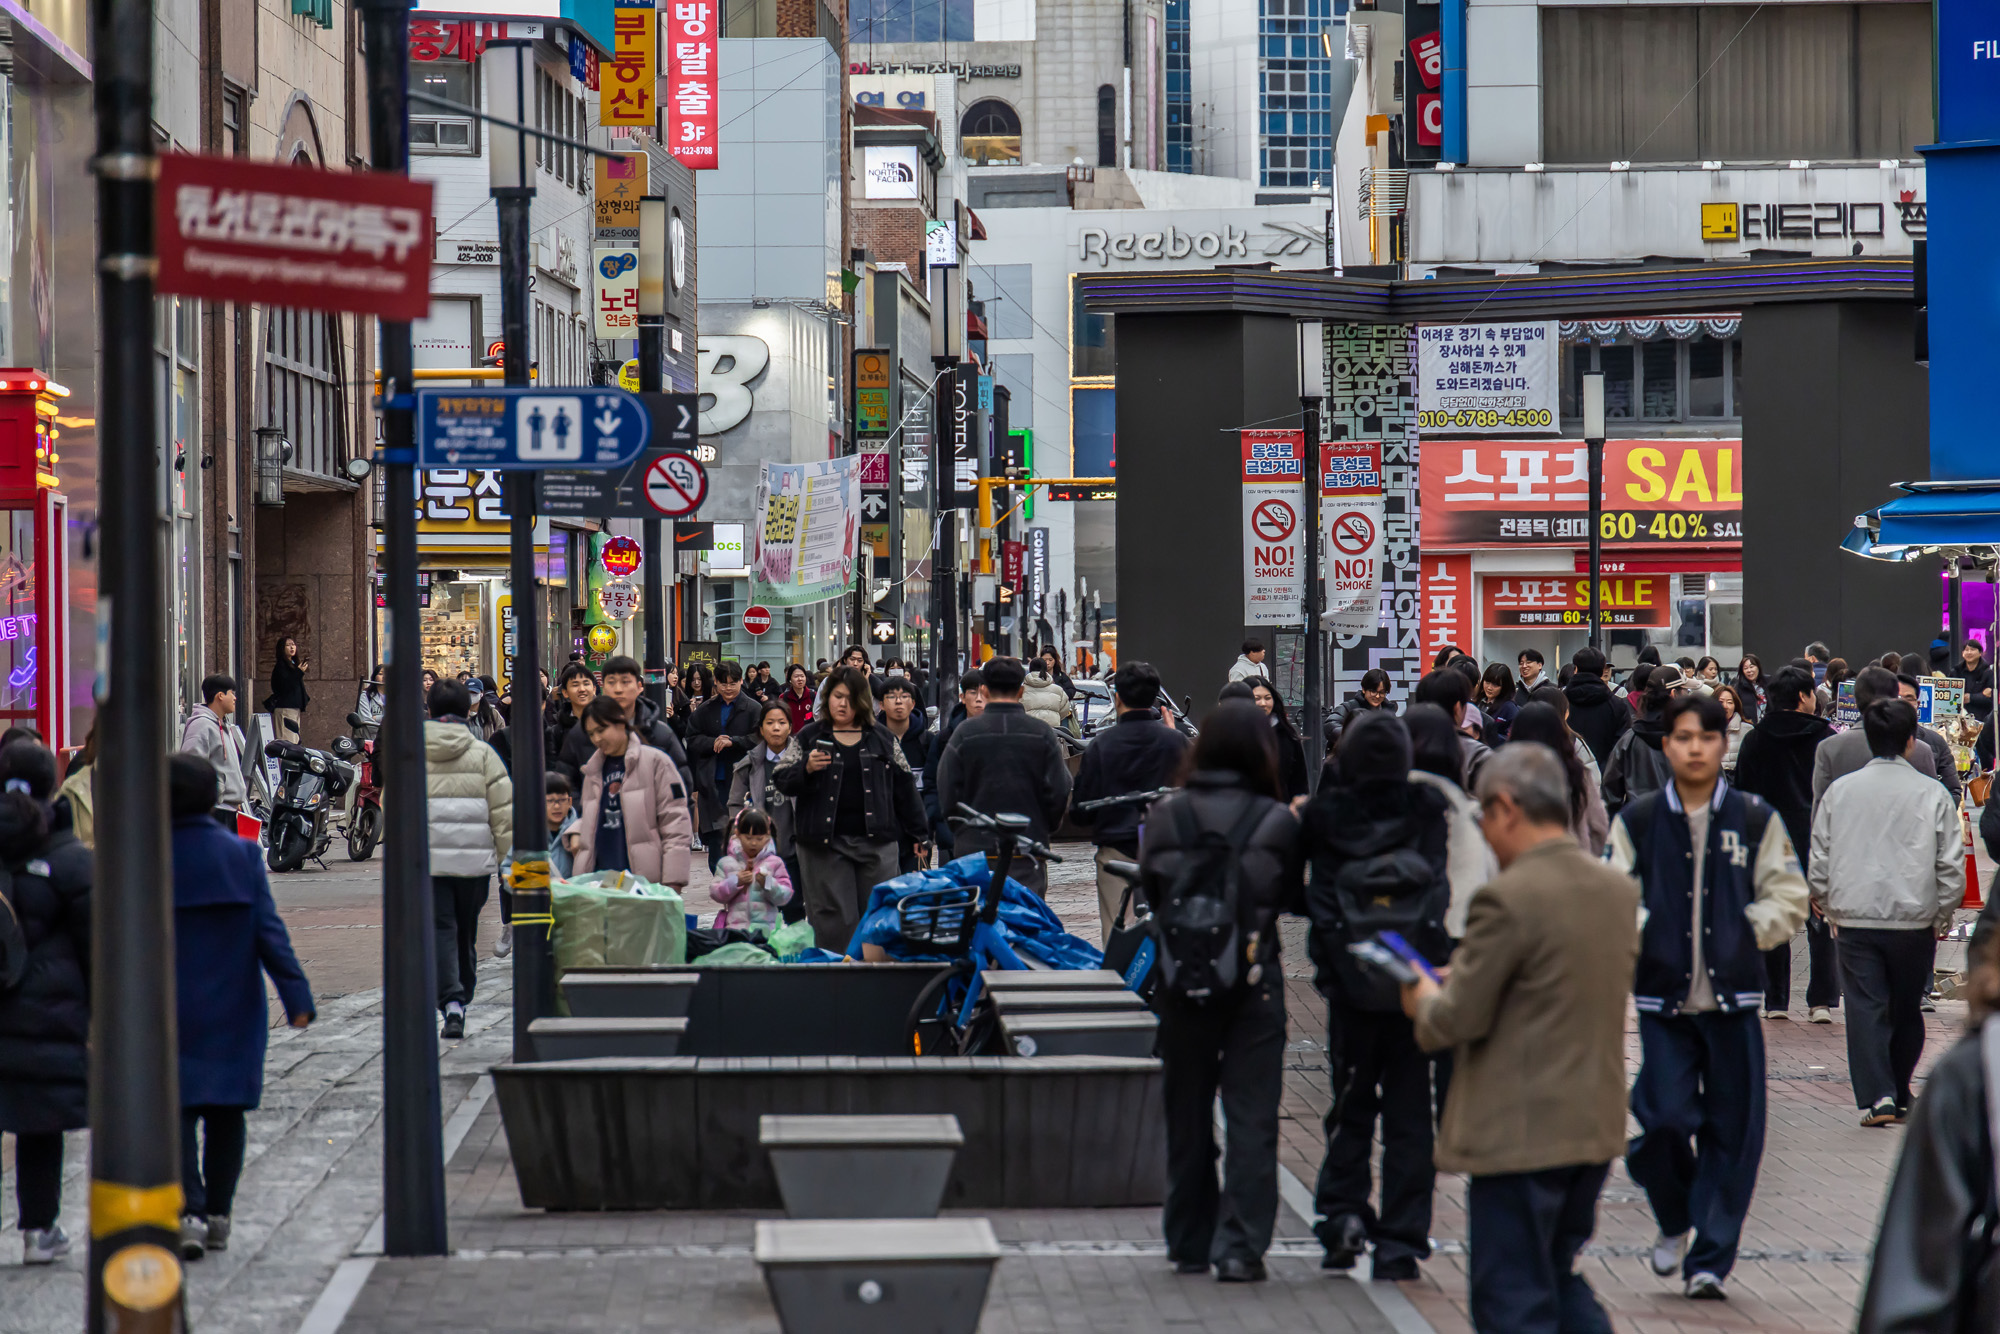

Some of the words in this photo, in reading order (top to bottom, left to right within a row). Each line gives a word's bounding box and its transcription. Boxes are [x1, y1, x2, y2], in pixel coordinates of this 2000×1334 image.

[527, 26, 536, 34] 3F
[675, 3, 711, 115] 방탈출
[611, 15, 648, 118] 부동산
[681, 122, 705, 141] 3F
[681, 146, 712, 155] 422-8788
[597, 215, 613, 225] 의원
[599, 229, 640, 238] 425-000
[1079, 224, 1248, 267] Reebok
[457, 253, 493, 262] 425-0009
[1421, 328, 1454, 341] 어려운
[1458, 328, 1481, 341] 경기
[1485, 328, 1496, 341] 속
[1500, 327, 1545, 341] 부담없이
[1439, 344, 1485, 358] 장사하실
[1489, 344, 1500, 357] 수
[1504, 344, 1526, 358] 있게
[1448, 361, 1517, 374] 심해돈까스가
[1435, 377, 1530, 391] 도와드리겠습니다.
[858, 392, 885, 404] 보드
[1440, 396, 1477, 408] 부담없이
[1478, 396, 1527, 408] 전화주세요!
[861, 405, 888, 420] 게임
[1419, 409, 1552, 427] 010-6788-4500
[1252, 443, 1293, 459] 동성로
[861, 455, 885, 468] 성형
[1246, 459, 1300, 474] 금연거리
[1331, 456, 1372, 471] 동성로
[1325, 471, 1379, 488] 금연거리
[1444, 448, 1607, 502] 스포츠
[1500, 517, 1588, 537] 전품목(최대
[713, 540, 741, 551] ocs
[606, 550, 637, 567] 노래
[1254, 546, 1295, 566] NO!
[1254, 567, 1295, 578] SMOKE
[1334, 558, 1374, 579] NO!
[1336, 580, 1373, 591] SMOKE
[602, 592, 639, 608] 부동산
[1494, 580, 1568, 606] 스포츠
[1575, 579, 1653, 607] SALE
[613, 609, 624, 618] 3F
[1428, 562, 1458, 656] 스포츠
[1563, 610, 1612, 624] 60~%
[1614, 614, 1635, 622] SALE
[1934, 691, 1951, 700] 00원
